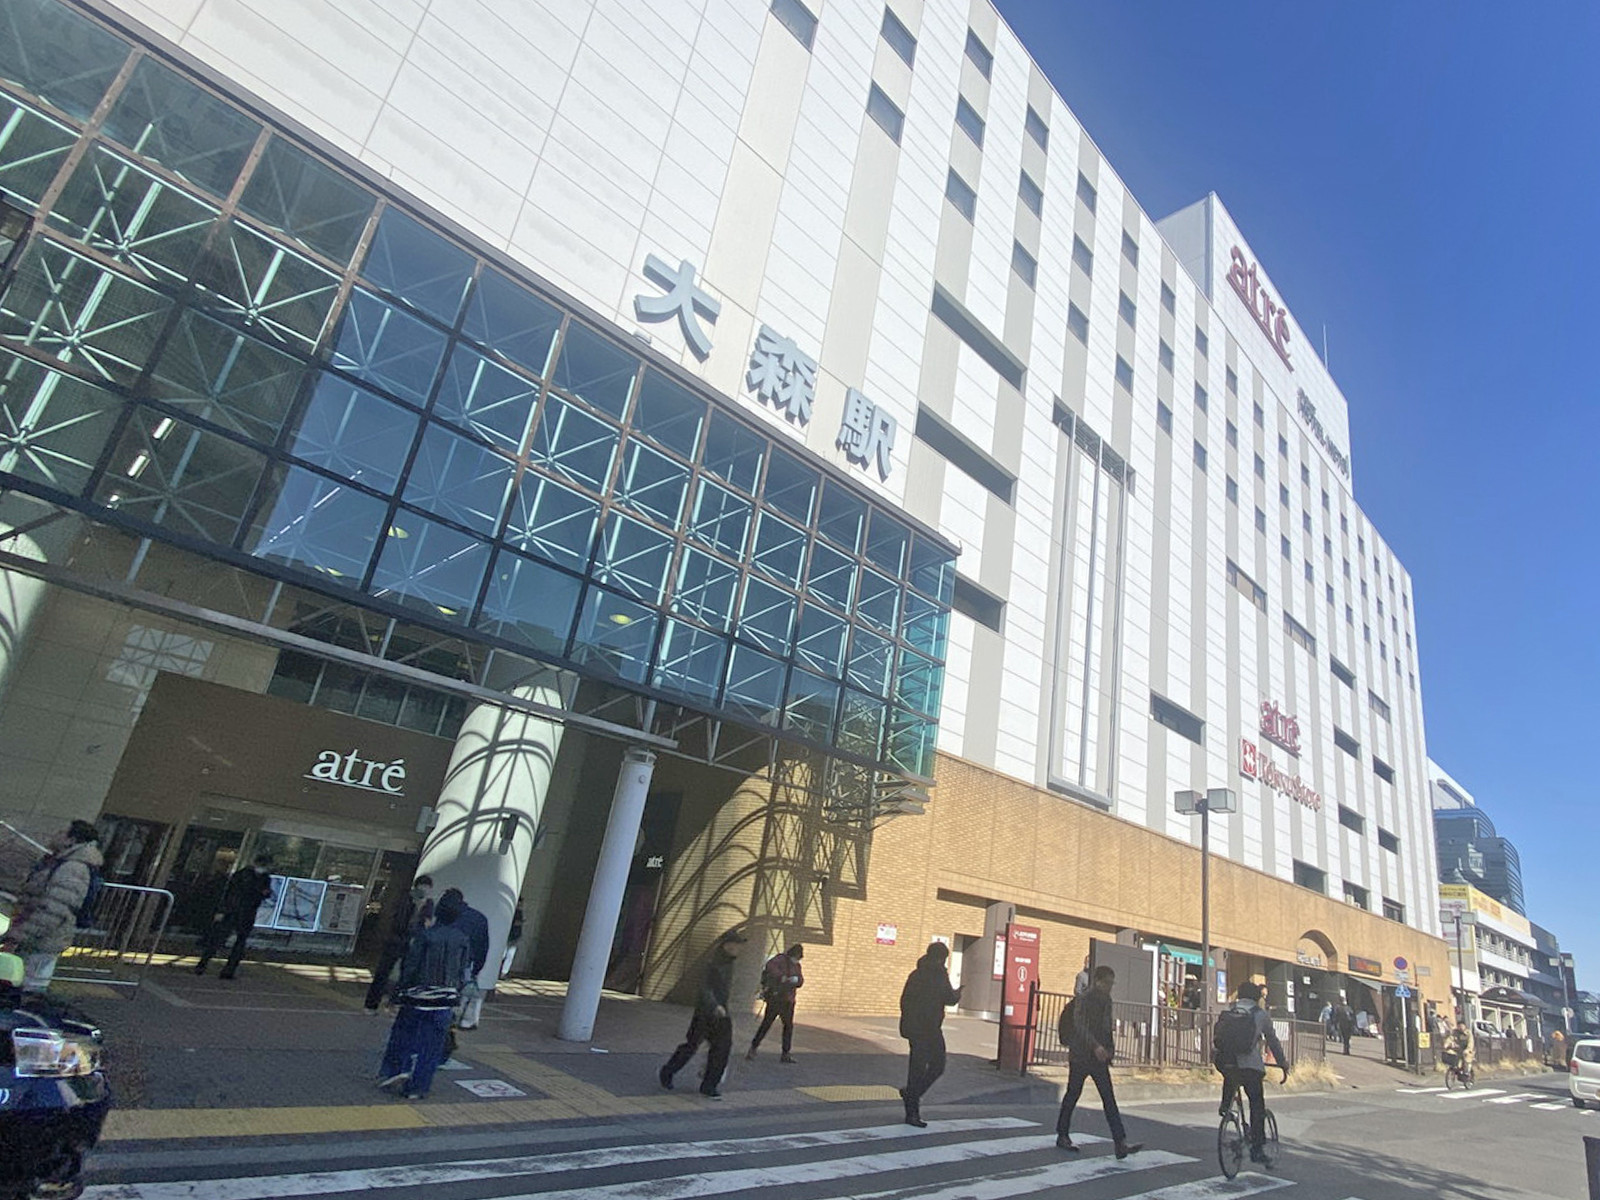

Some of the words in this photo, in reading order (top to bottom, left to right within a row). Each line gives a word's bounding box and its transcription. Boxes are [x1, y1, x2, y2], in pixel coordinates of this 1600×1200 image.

[633, 252, 897, 483] 大森駅
[311, 749, 406, 792] atré
